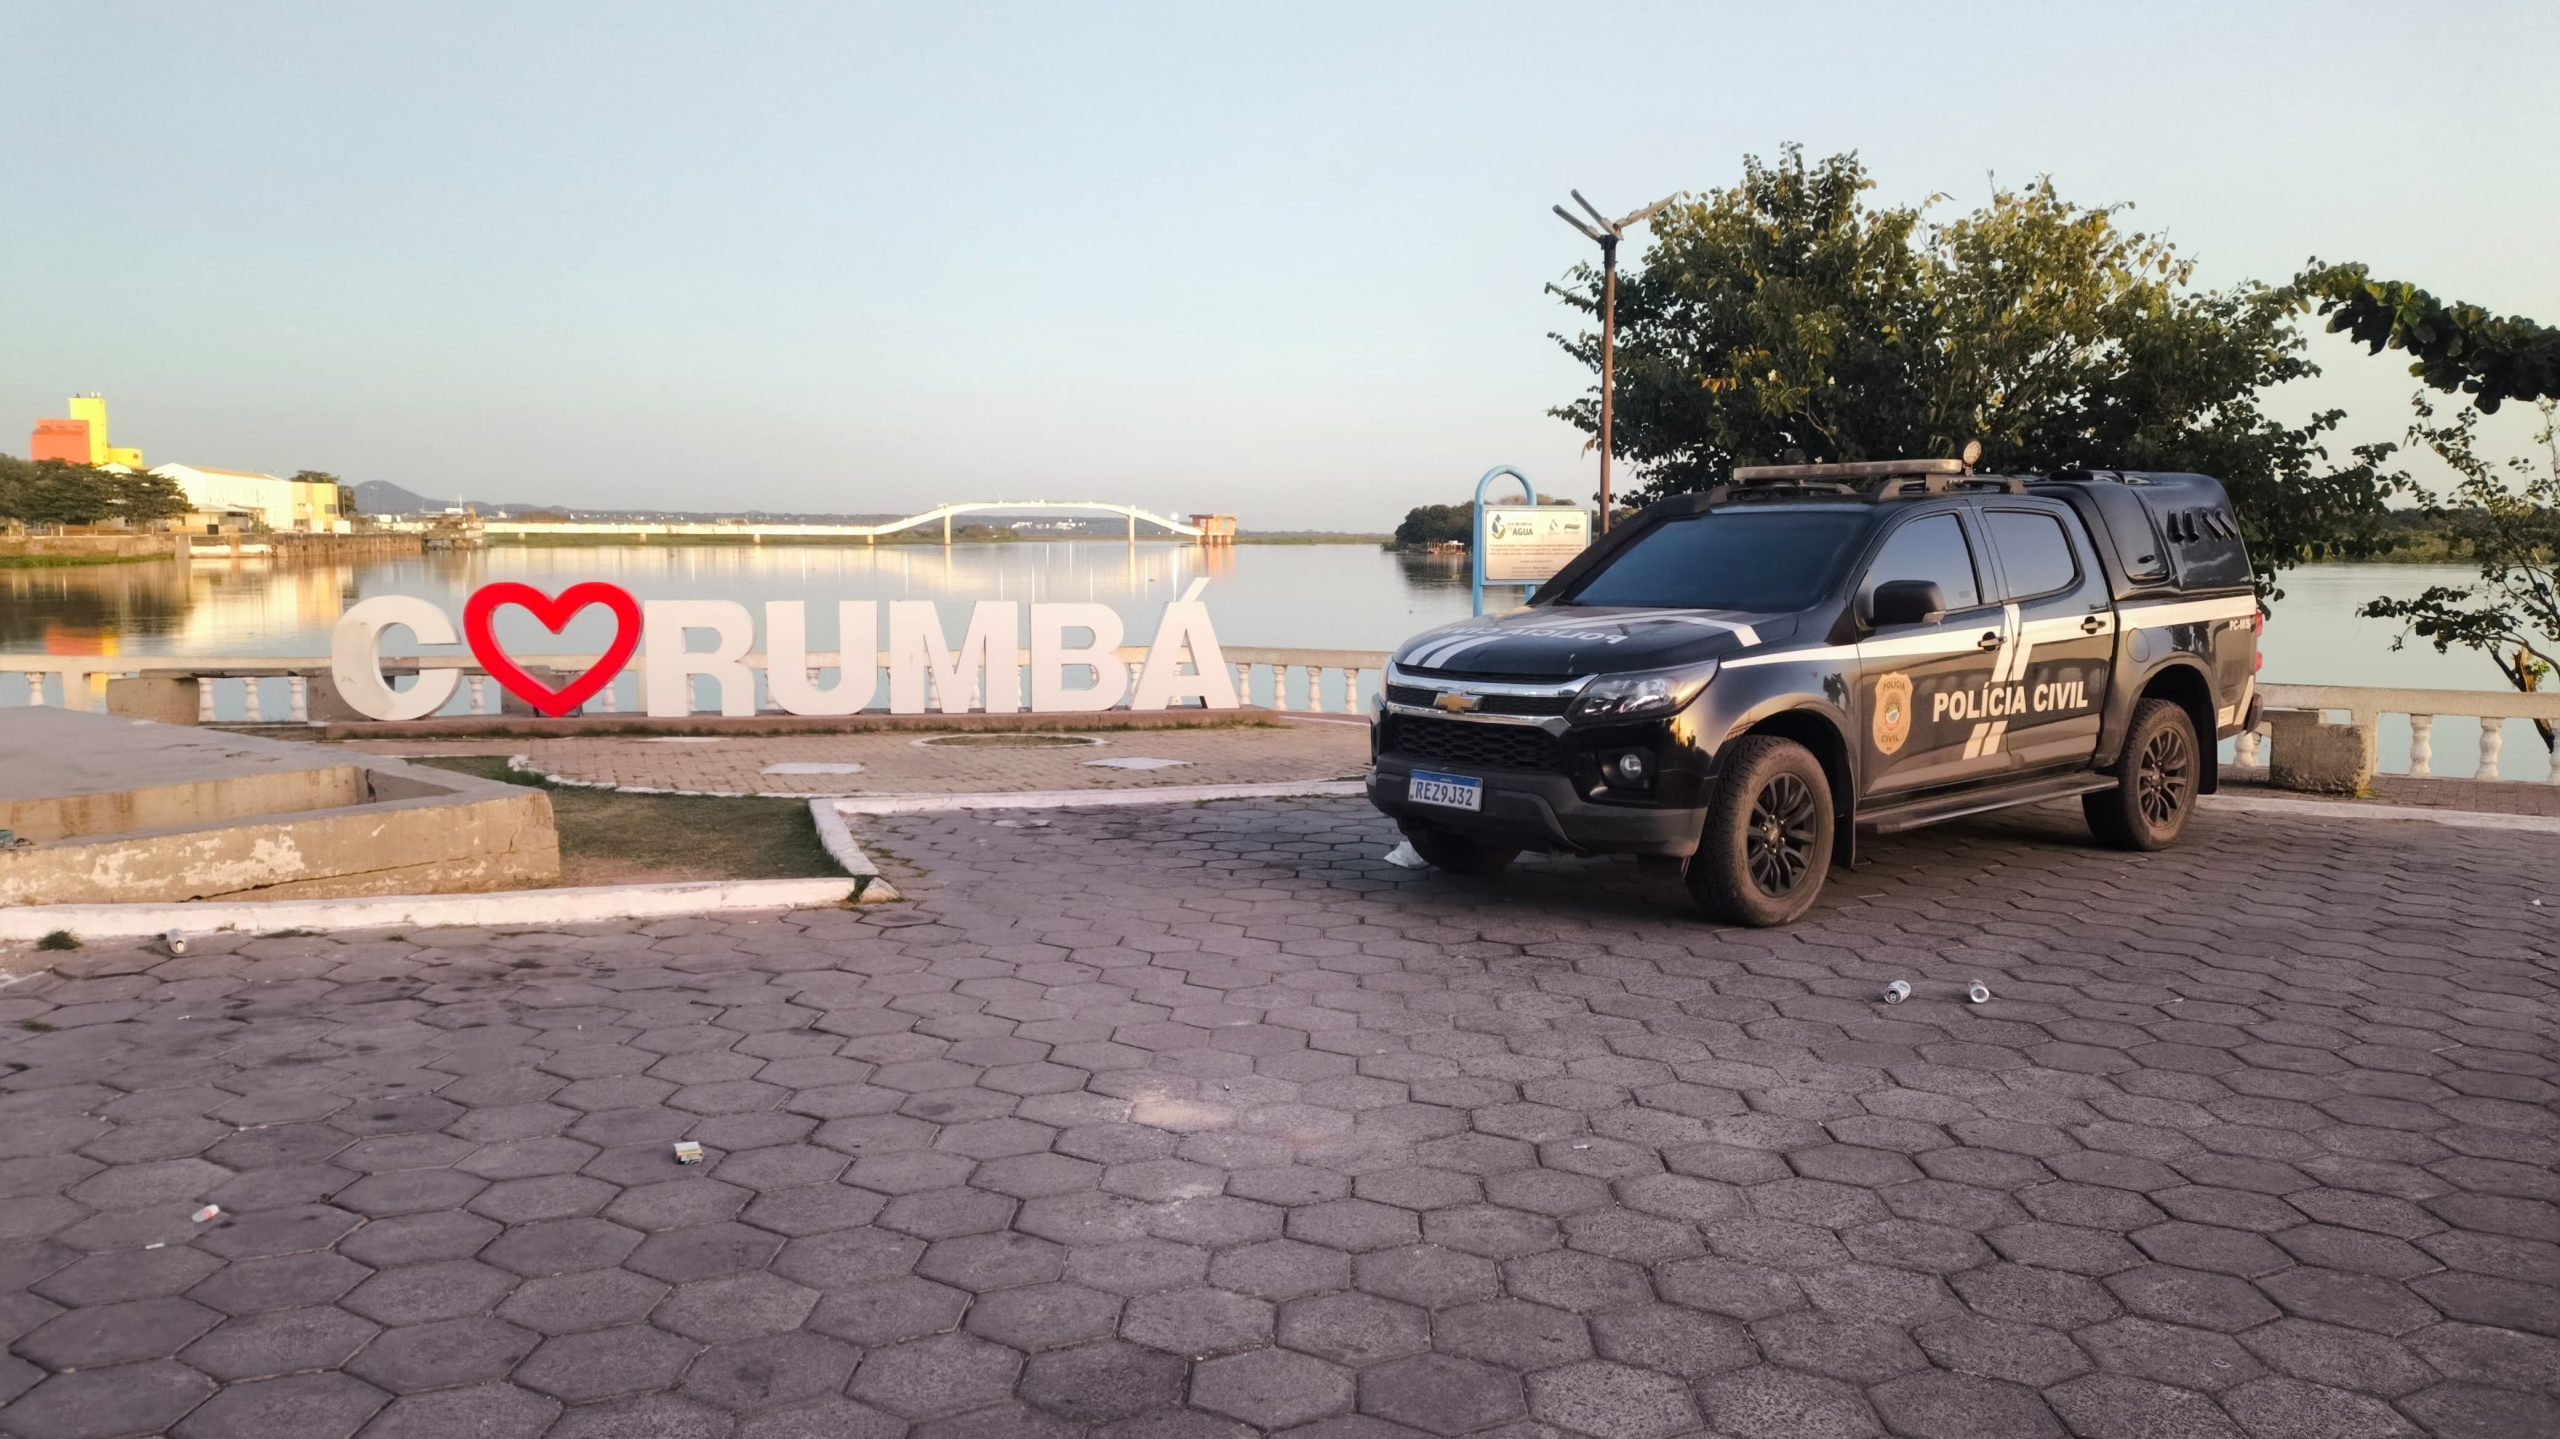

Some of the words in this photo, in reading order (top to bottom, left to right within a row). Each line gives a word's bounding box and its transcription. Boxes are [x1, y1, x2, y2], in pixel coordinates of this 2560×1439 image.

[1932, 682, 2026, 723] POLÍCIA
[2033, 681, 2089, 713] CIVIL
[1415, 781, 1473, 807] REZ9J32
